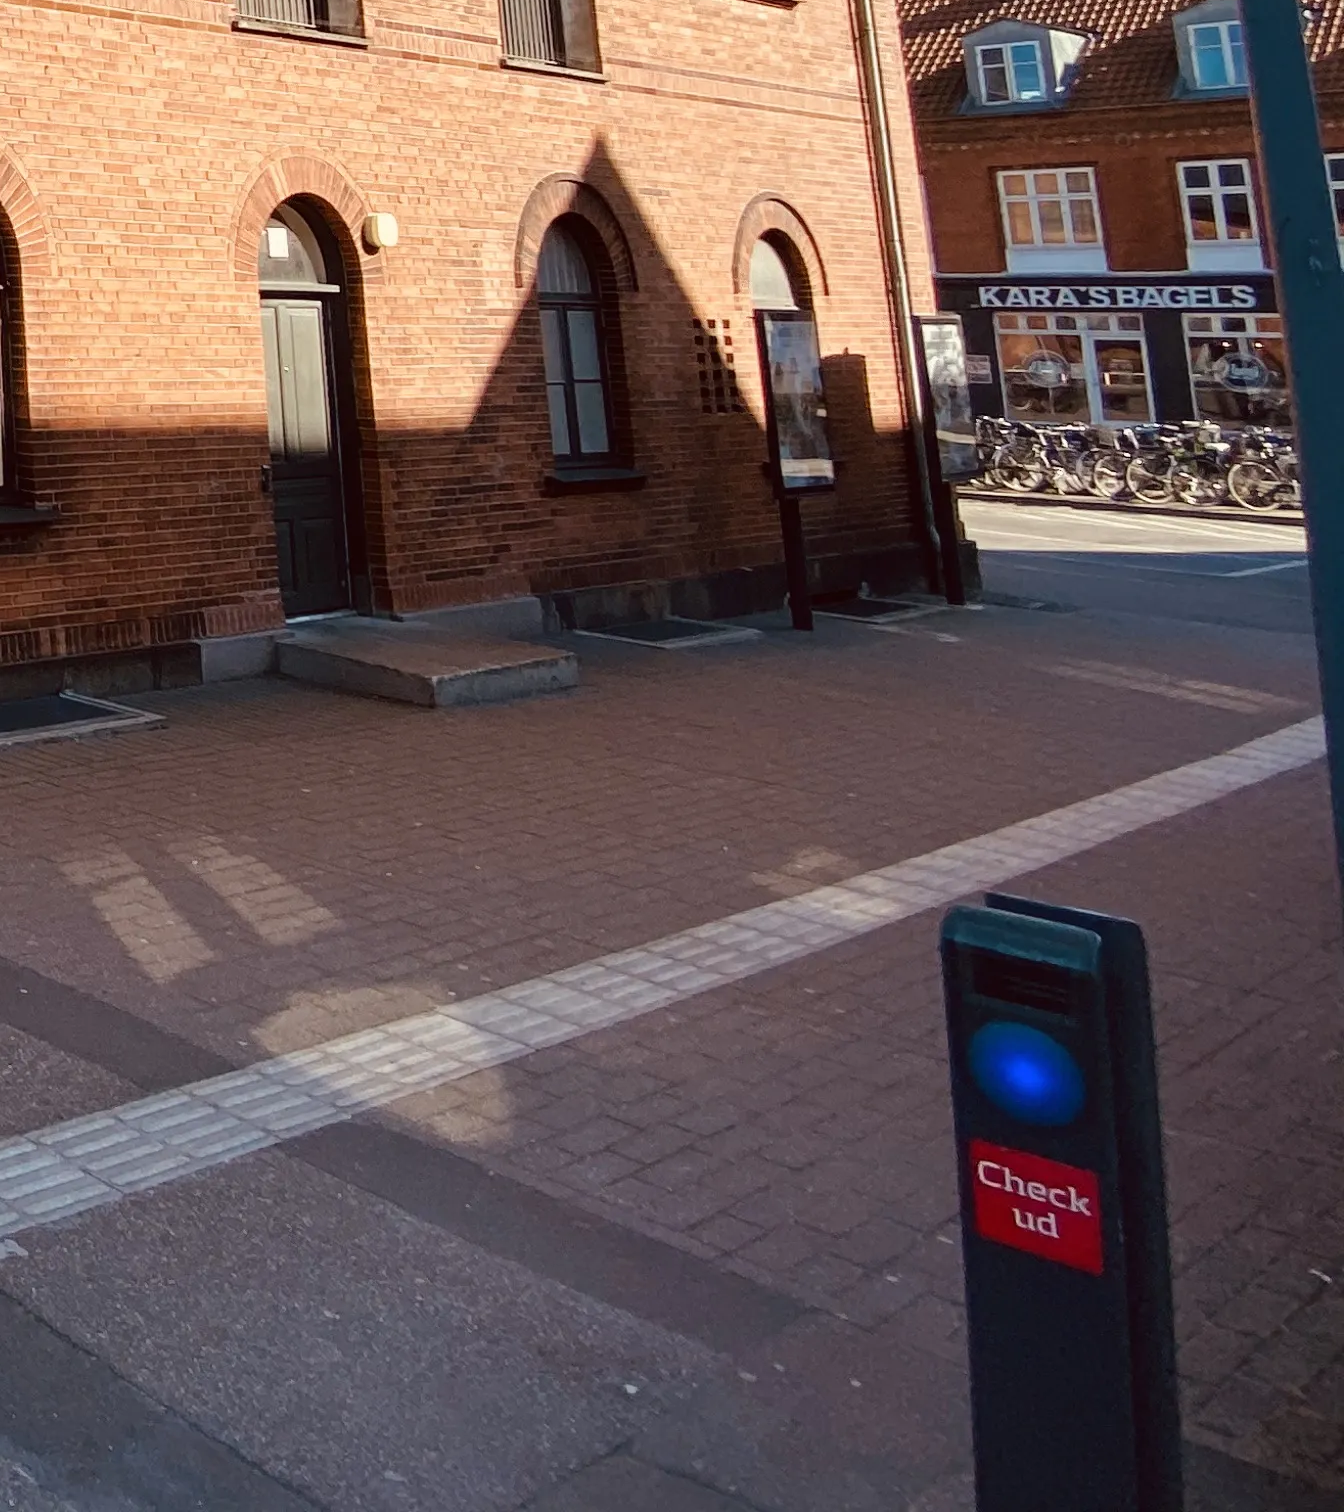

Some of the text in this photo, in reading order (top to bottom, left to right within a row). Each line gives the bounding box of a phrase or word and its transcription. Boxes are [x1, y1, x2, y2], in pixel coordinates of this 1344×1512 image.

[978, 285, 1257, 308] KARA'S BAGELS
[977, 1160, 1092, 1216] Check
[1012, 1207, 1060, 1239] ud
